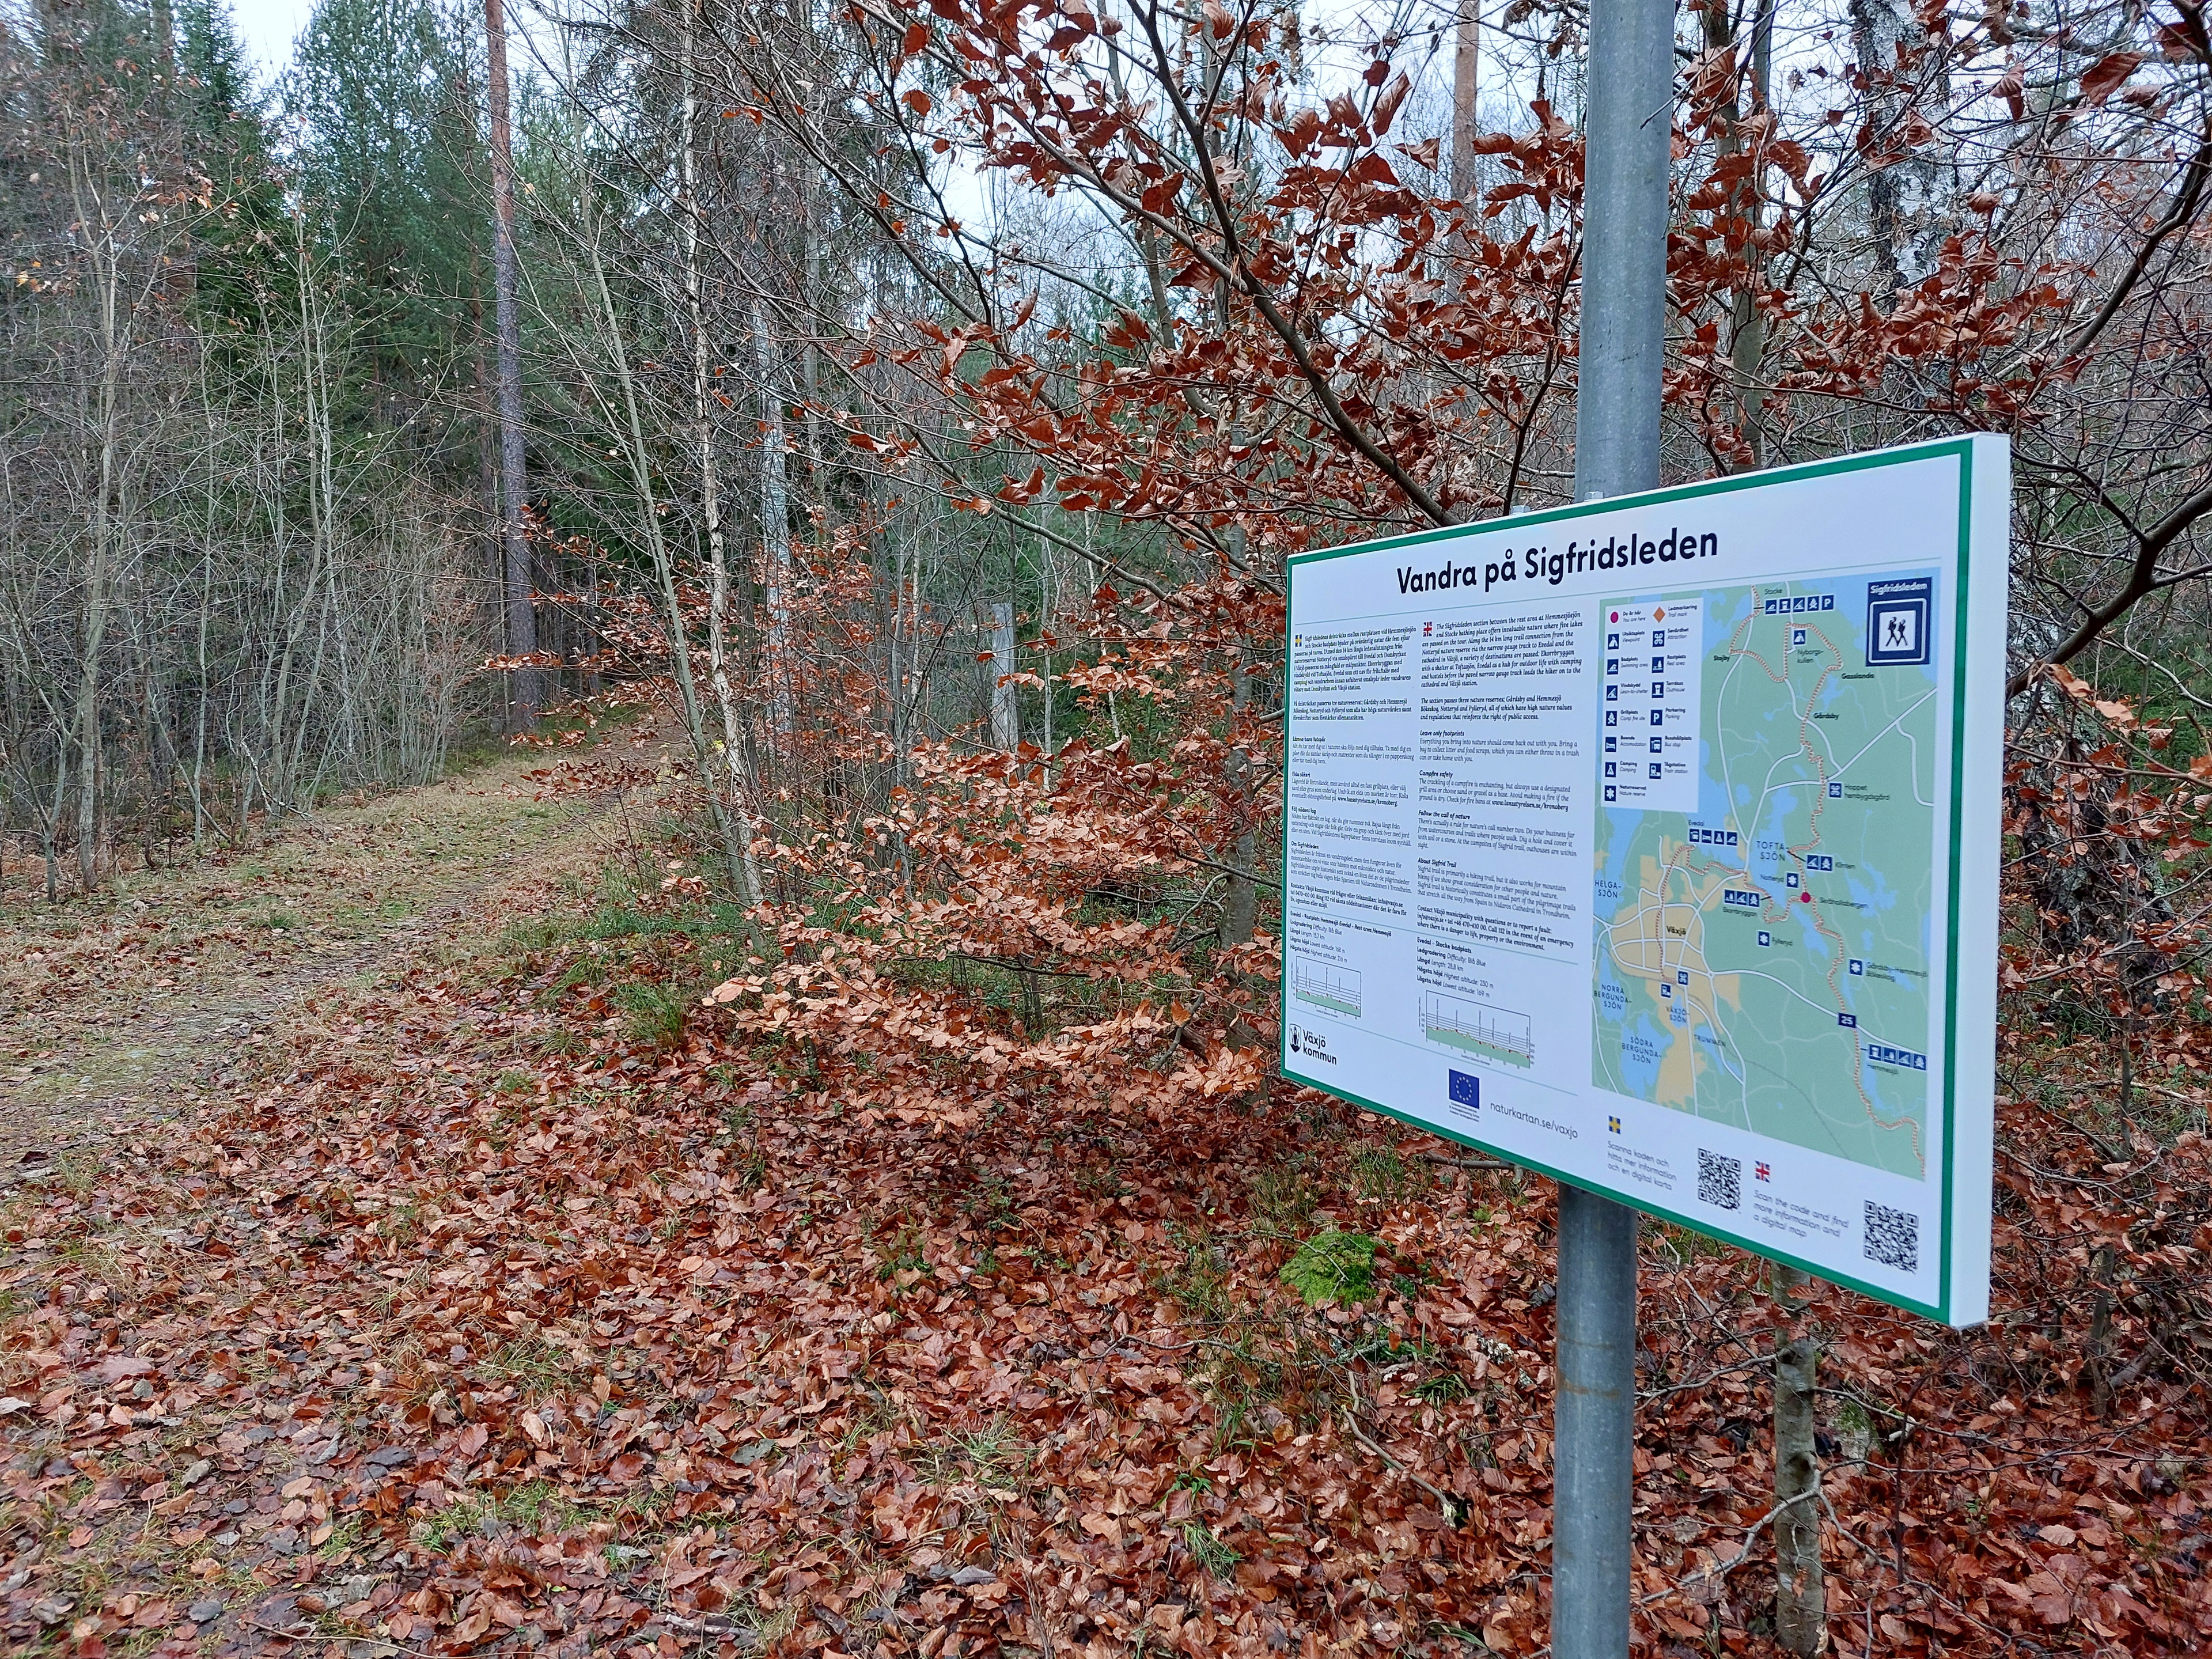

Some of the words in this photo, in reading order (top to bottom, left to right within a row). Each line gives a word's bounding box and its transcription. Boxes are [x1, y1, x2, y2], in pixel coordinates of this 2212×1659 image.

[1397, 561, 1477, 594] Vandra
[1485, 548, 1516, 592] på
[1525, 527, 1718, 585] Sigfridsleden
[1870, 582, 1927, 594] Sigfridsleden
[1444, 620, 1472, 630] Sigfridsleden
[1544, 612, 1581, 621] Hemmesjösjön
[1475, 628, 1487, 637] place
[1433, 729, 1442, 738] only
[1442, 729, 1464, 738] footprints
[1419, 769, 1438, 778] Campfire
[1439, 770, 1453, 779] safety
[1756, 841, 1789, 851] TOFTA-
[1417, 857, 1430, 865] About
[1431, 858, 1446, 868] Sigfrid
[1760, 851, 1785, 861] SJÖN
[1594, 880, 1622, 889] HELGA-
[1598, 889, 1618, 898] SJÖN
[1666, 925, 1687, 936] Växjö
[1417, 936, 1431, 945] Evedal
[1435, 940, 1450, 949] Stocke
[1450, 943, 1472, 953] badplats
[1417, 945, 1446, 960] Ledgradering
[1446, 952, 1467, 964] Difficulty:
[1476, 959, 1486, 967] Blue
[1417, 955, 1430, 965] Längd
[1431, 958, 1446, 968] Length:
[1417, 965, 1432, 975] Högsta
[1433, 968, 1443, 978] höjd
[1444, 971, 1460, 980] Highest
[1460, 975, 1478, 985] altitude:
[1417, 974, 1431, 984] Lägsta
[1431, 978, 1442, 987] höjd
[1442, 980, 1457, 990] Lowest
[1457, 984, 1475, 994] altitude:
[1476, 988, 1484, 997] 169
[1601, 984, 1624, 994] NORRA
[1594, 990, 1632, 1003] BERGUNDA-
[1604, 1001, 1622, 1010] SJÖN
[1669, 1013, 1687, 1023] SJÖN
[1840, 1016, 1853, 1025] 25
[1303, 1029, 1326, 1050] Växjö
[1630, 1036, 1654, 1048] SÖDRA
[1303, 1046, 1337, 1065] kommun
[1622, 1043, 1662, 1057] BERGUNDA-
[1633, 1053, 1652, 1064] SJÖN
[1490, 1102, 1578, 1140] naturkartan.se/vaxjo
[1608, 1140, 1632, 1155] Scanna
[1633, 1148, 1654, 1162] koden
[1656, 1158, 1669, 1167] och
[1608, 1150, 1622, 1162] hitta
[1623, 1158, 1636, 1167] mer
[1638, 1161, 1677, 1180] information
[1608, 1164, 1620, 1172] och
[1631, 1169, 1652, 1183] digital
[1653, 1177, 1672, 1190] karta
[1753, 1188, 1772, 1203] Scan
[1775, 1196, 1787, 1207] the
[1789, 1203, 1810, 1215] code
[1812, 1210, 1830, 1221] and
[1831, 1214, 1849, 1228] find
[1753, 1203, 1772, 1214] more
[1774, 1208, 1820, 1230] information
[1822, 1225, 1840, 1237] and
[1761, 1214, 1787, 1230] digital
[1788, 1225, 1807, 1238] map
